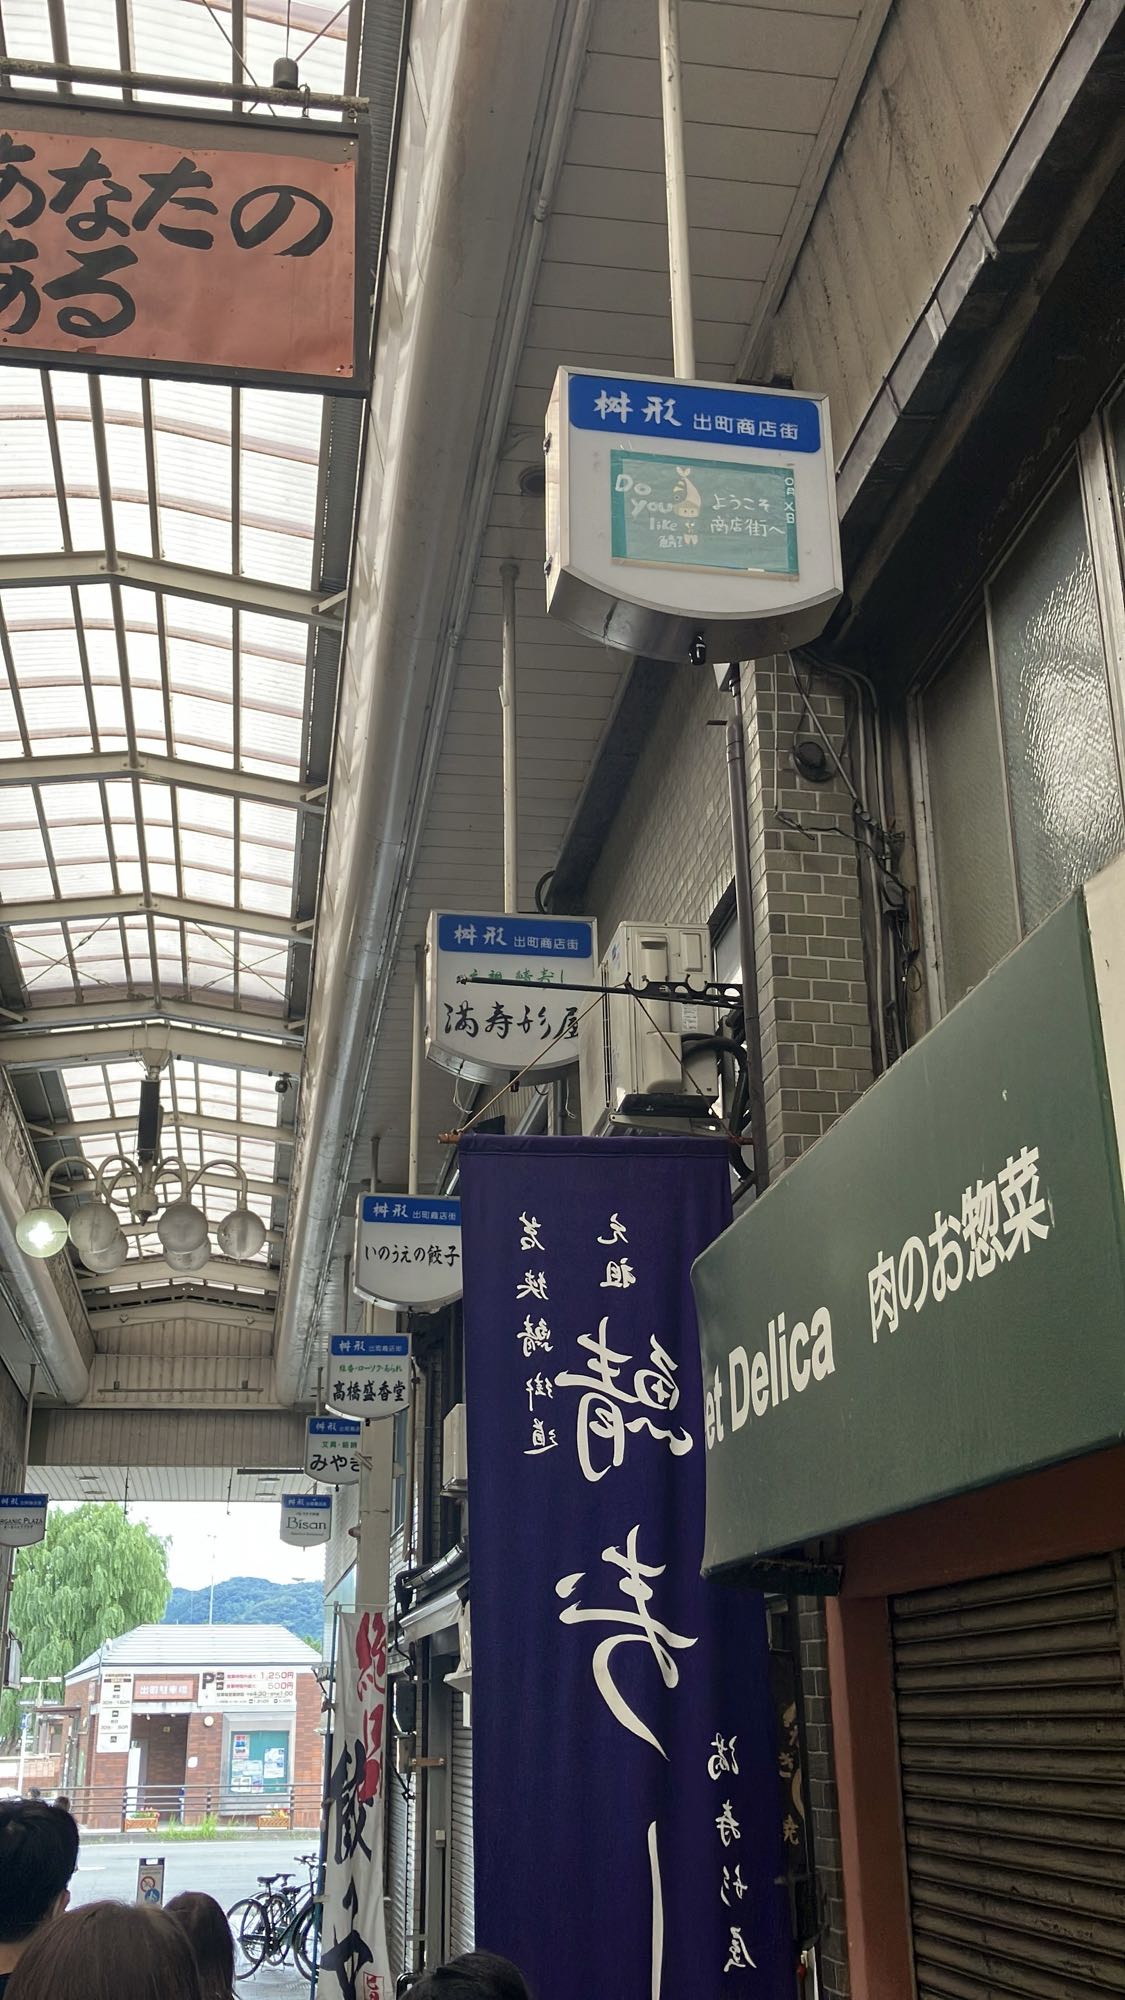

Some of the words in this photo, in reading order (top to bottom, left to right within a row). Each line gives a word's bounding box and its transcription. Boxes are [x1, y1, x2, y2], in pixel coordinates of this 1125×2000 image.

[693, 412, 799, 441] 出町商店街
[614, 473, 652, 496] Do
[630, 497, 674, 518] you
[711, 494, 771, 513] ようこそ
[649, 517, 679, 532] like
[710, 515, 786, 538] 商店街へ
[513, 935, 579, 951] 出町商店街
[365, 1244, 461, 1268] いのうえの餃子
[868, 1146, 1050, 1343] 肉のお惣菜
[728, 1306, 836, 1432] Delica
[286, 1516, 327, 1530] Bisan
